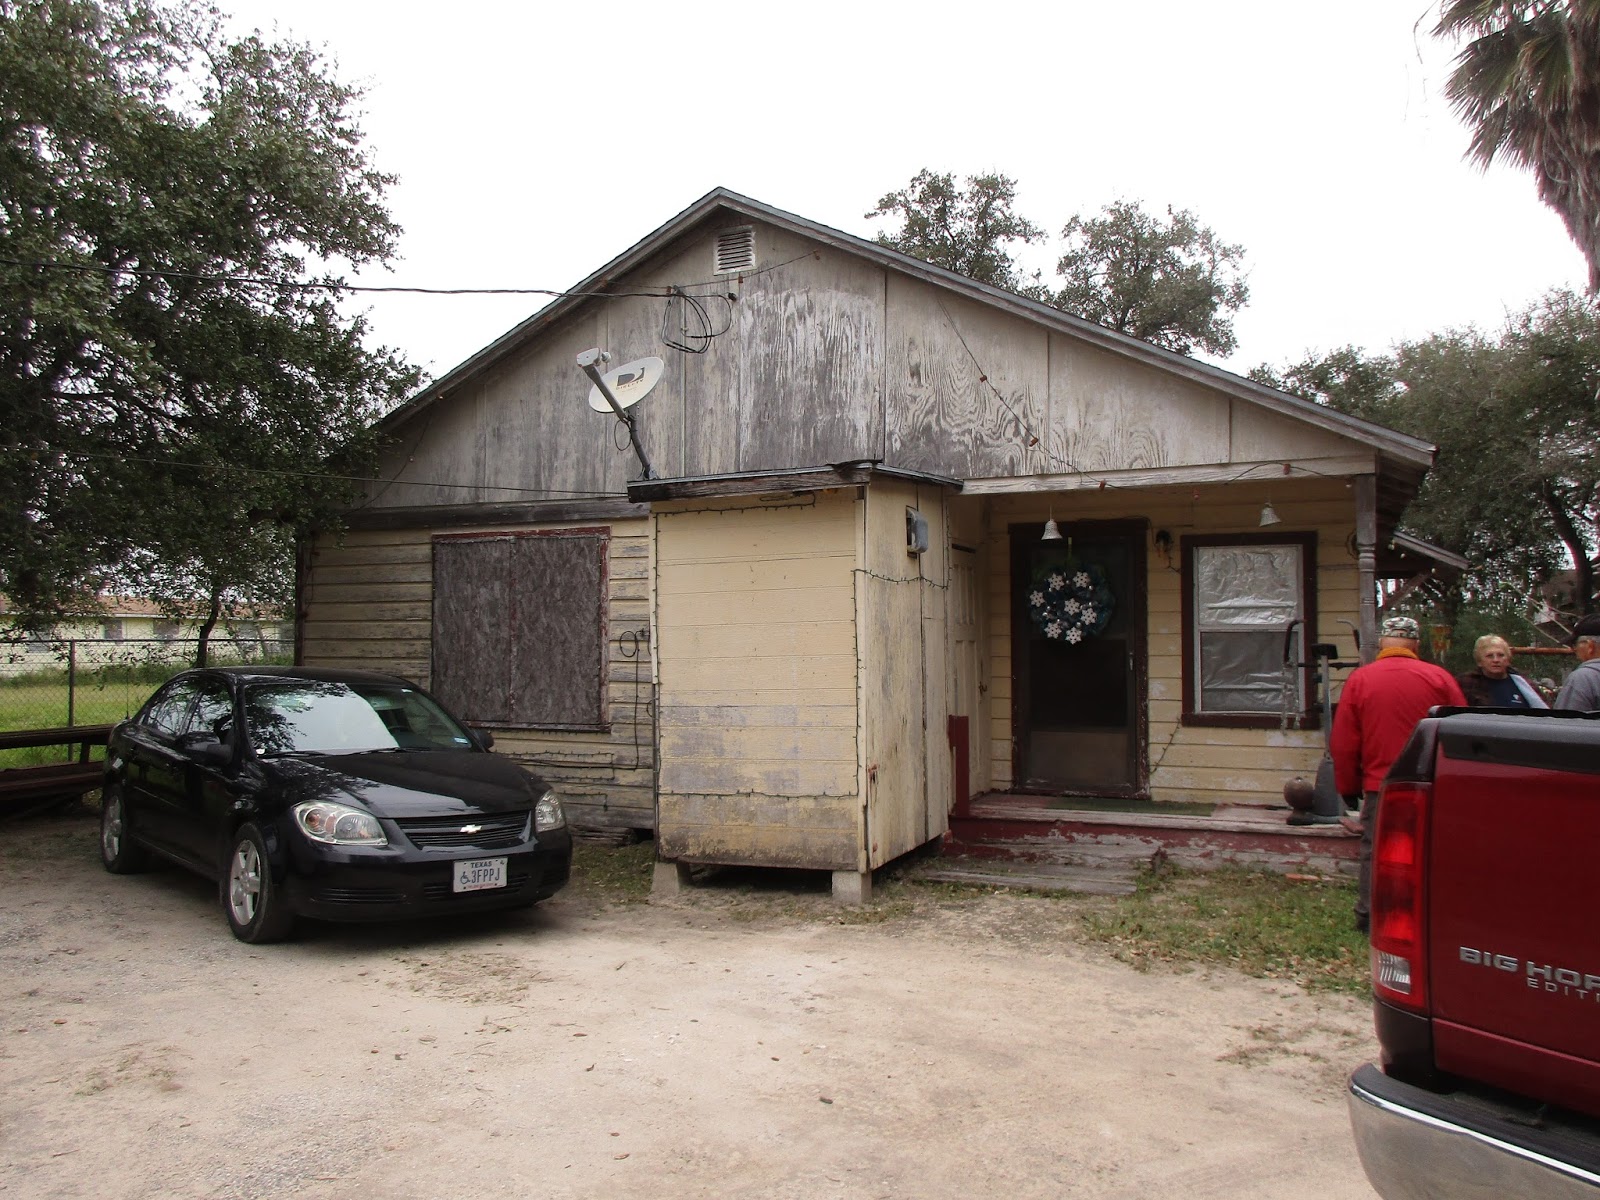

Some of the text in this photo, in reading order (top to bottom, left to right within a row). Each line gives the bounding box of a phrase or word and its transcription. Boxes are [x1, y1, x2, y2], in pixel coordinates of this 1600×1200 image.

[470, 861, 493, 869] TEXAS
[471, 867, 500, 884] 3FPPJ
[1459, 946, 1519, 972] BIG
